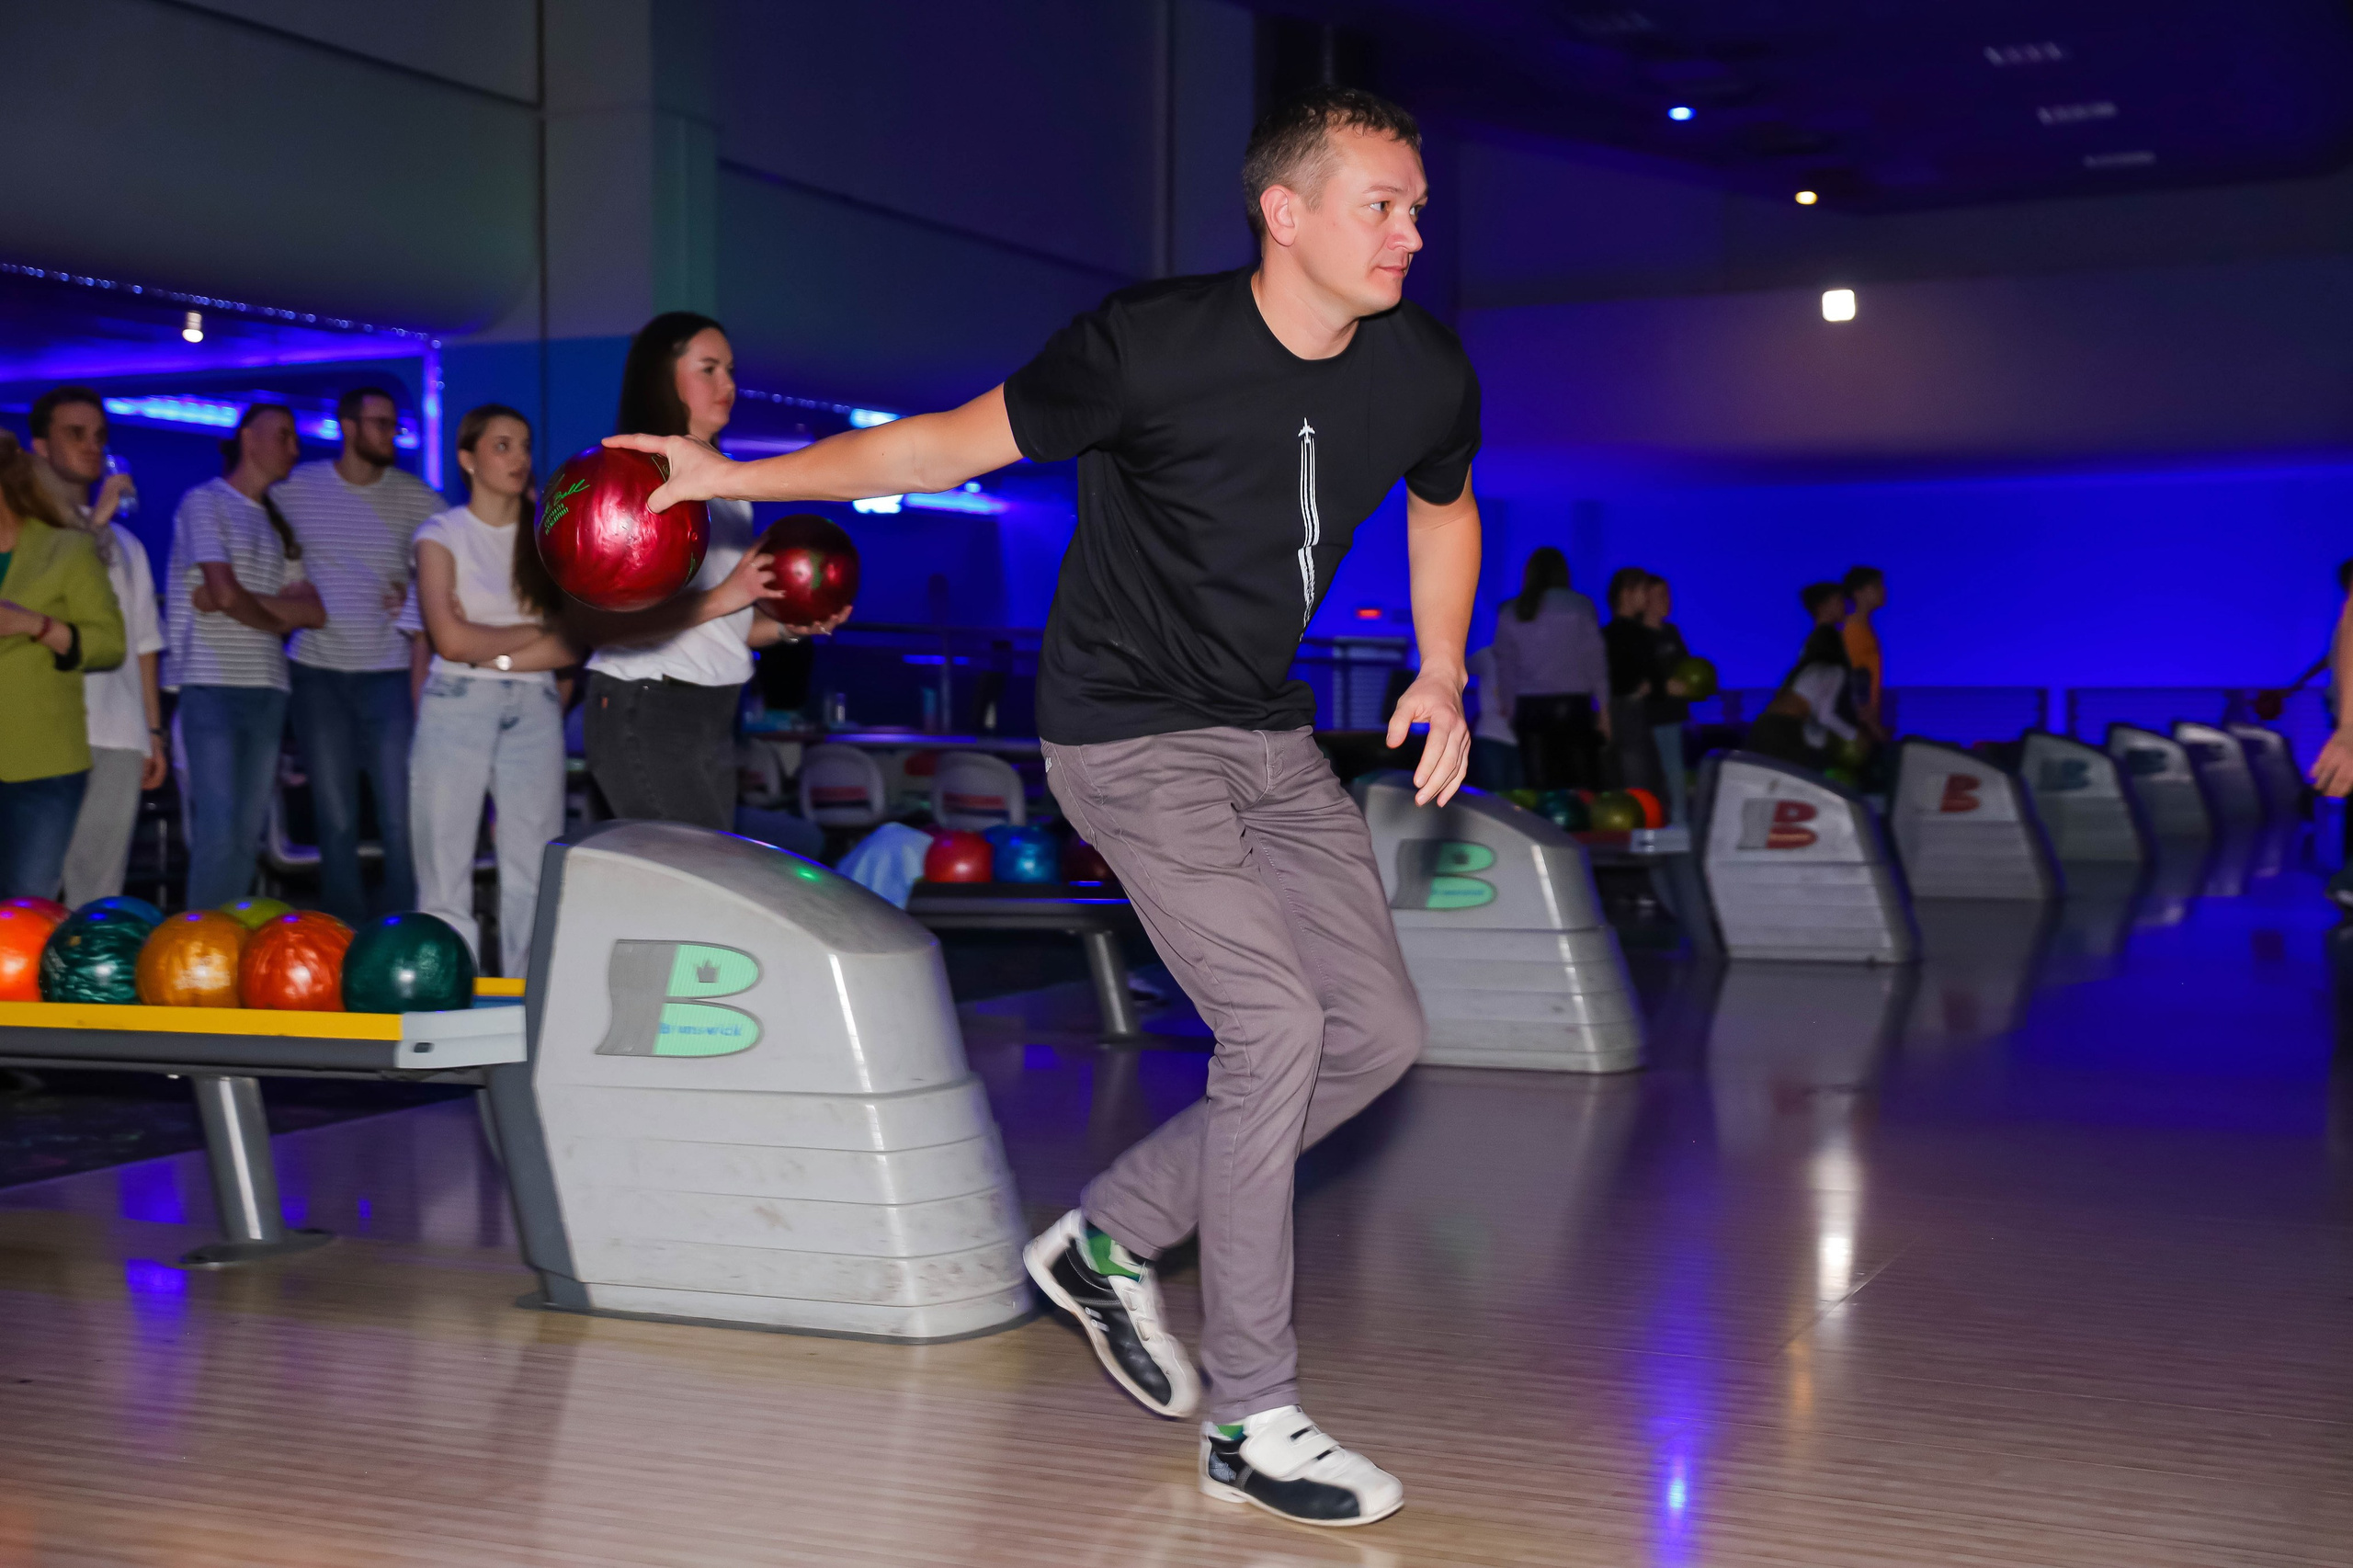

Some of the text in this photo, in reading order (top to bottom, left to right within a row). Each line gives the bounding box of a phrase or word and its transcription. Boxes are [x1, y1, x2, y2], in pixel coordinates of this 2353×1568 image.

[1766, 801, 1817, 849] B
[1390, 839, 1497, 911] B
[594, 939, 763, 1059] B
[659, 1022, 742, 1036] Brunswick
